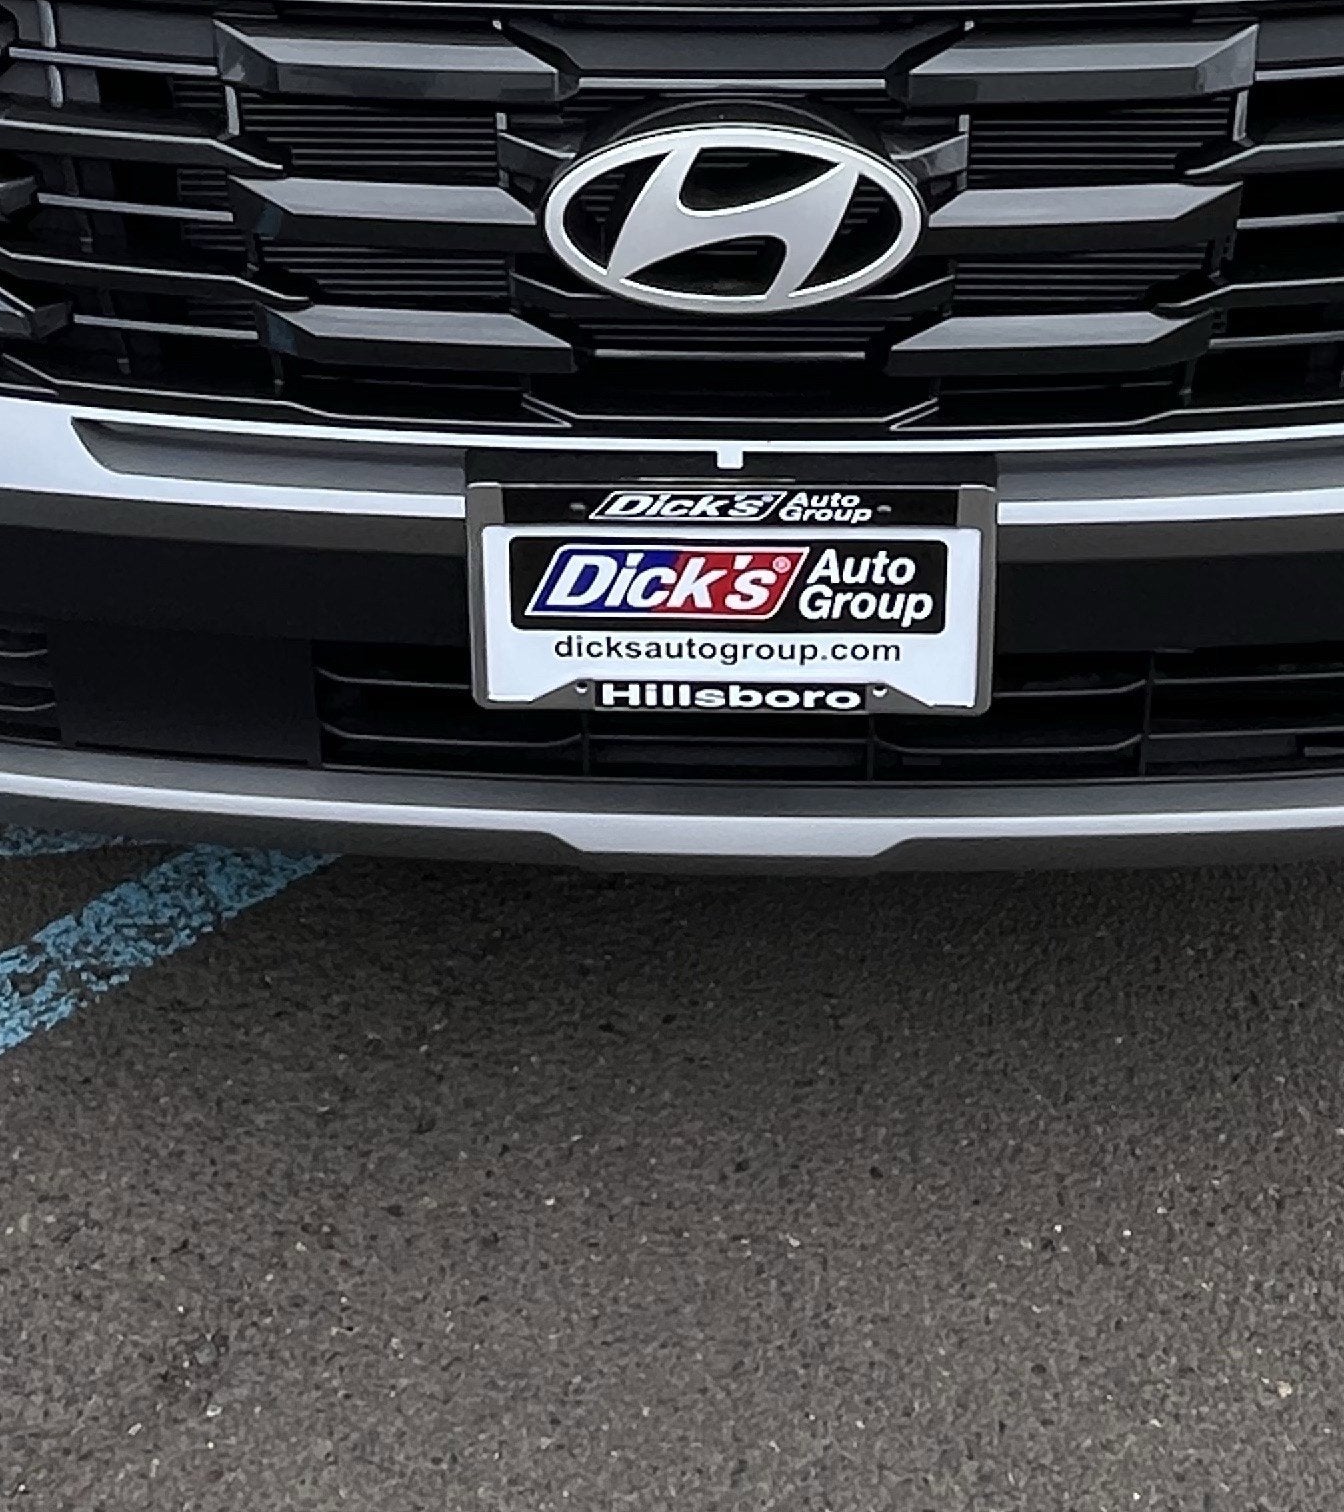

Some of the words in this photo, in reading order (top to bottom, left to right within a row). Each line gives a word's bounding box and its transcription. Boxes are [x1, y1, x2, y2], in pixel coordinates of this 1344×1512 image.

[607, 493, 766, 518] Dick's
[783, 491, 861, 509] Auto
[779, 506, 872, 524] Group
[545, 552, 774, 611] Dick's
[806, 549, 916, 585] Auto
[798, 585, 933, 628] Group
[554, 635, 901, 665] dicksautogroup.com
[601, 683, 861, 710] Hillsboro
